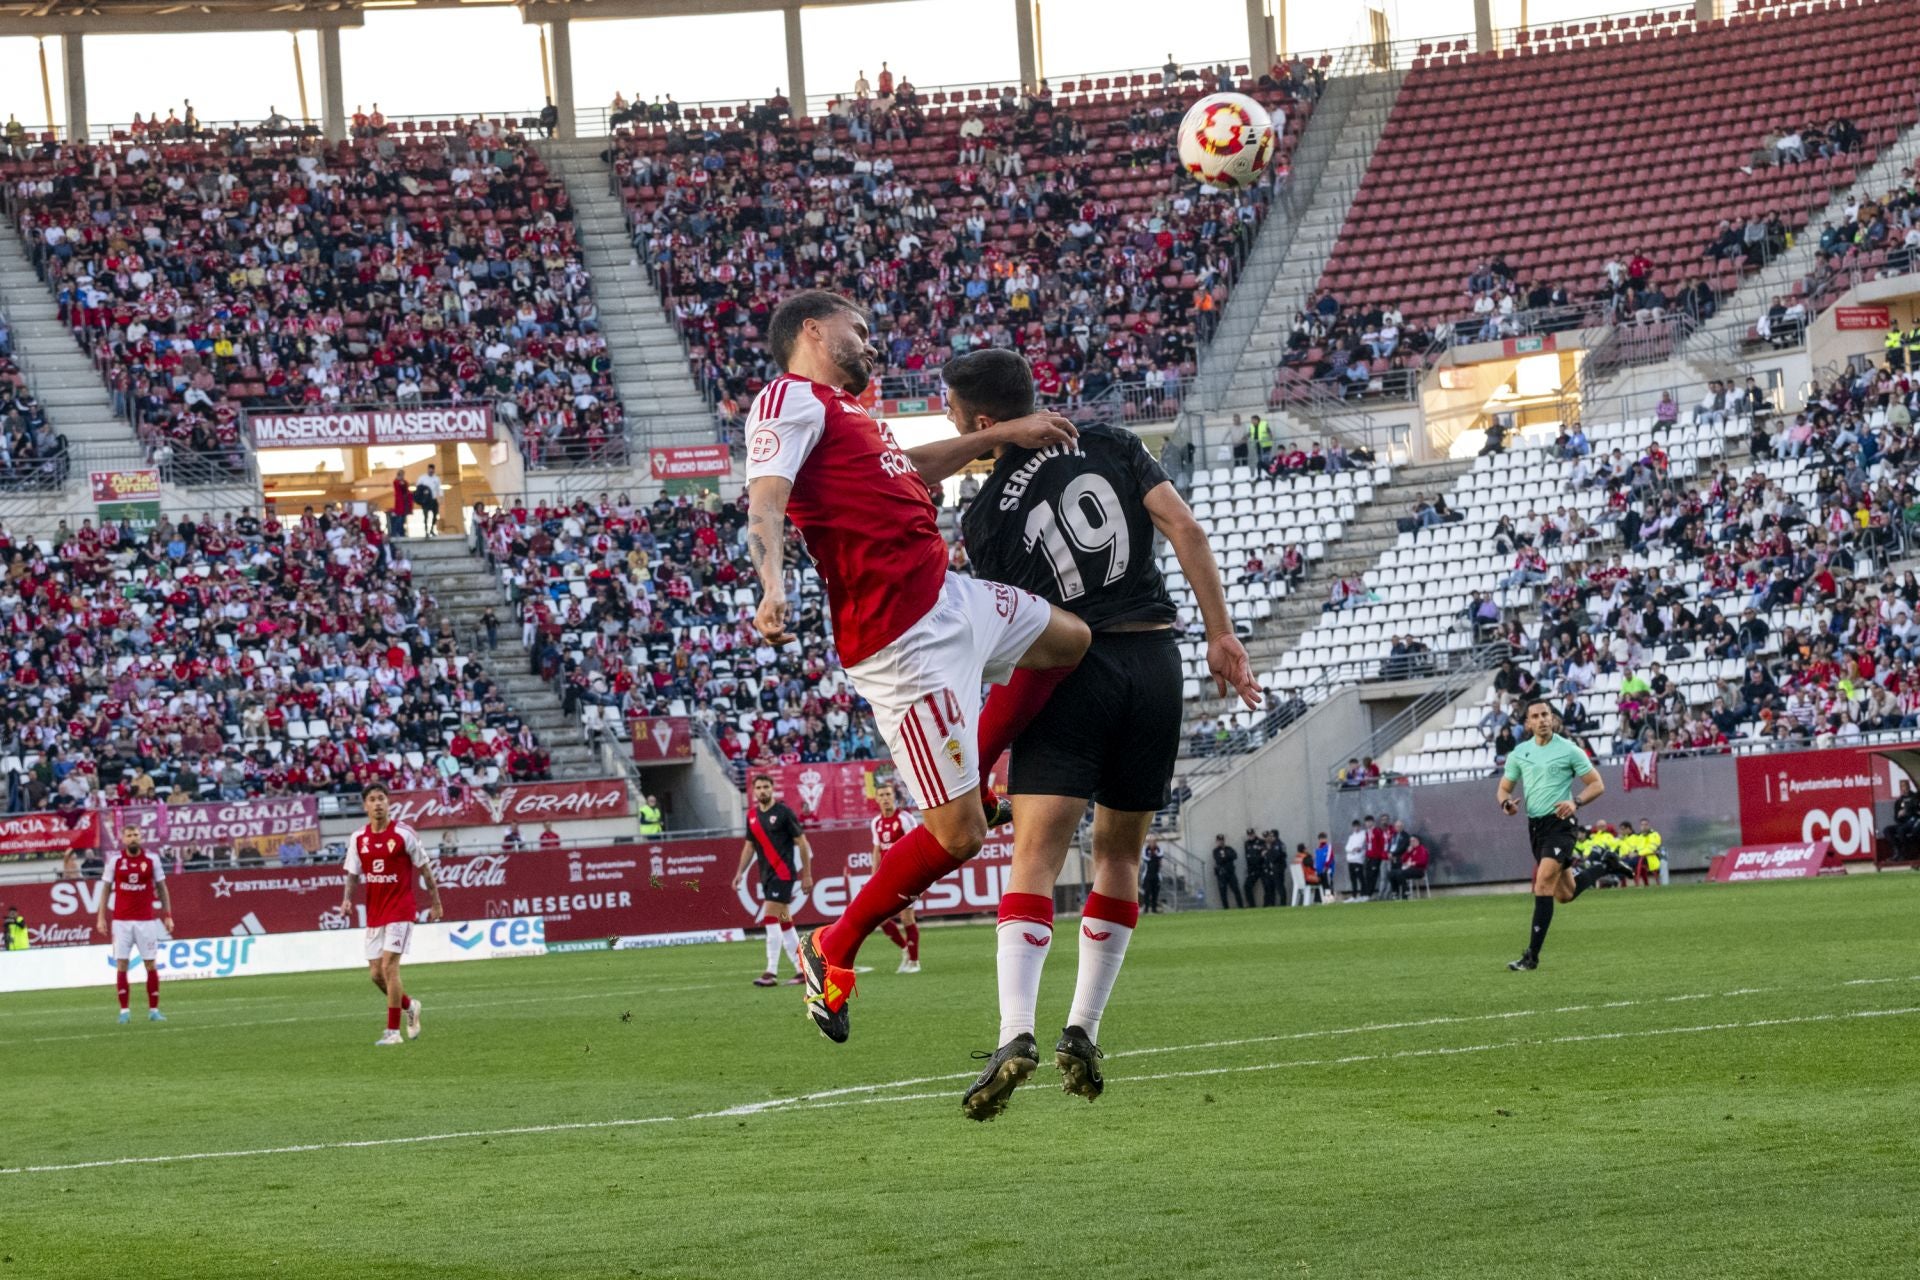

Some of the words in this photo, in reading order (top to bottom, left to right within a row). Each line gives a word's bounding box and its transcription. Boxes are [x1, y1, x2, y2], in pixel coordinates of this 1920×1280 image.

[255, 414, 369, 440] MASERCON
[374, 409, 486, 435] MASERCON
[1022, 472, 1130, 602] 19
[923, 687, 966, 739] 14
[1789, 776, 1842, 793] Ayuntamiento
[1843, 775, 1854, 788] de
[515, 791, 621, 814] GRANA
[141, 807, 209, 827] PEÑA
[217, 800, 305, 823] GRANA
[0, 817, 45, 836] URCIA
[169, 819, 264, 842] RINCON
[272, 815, 318, 836] DEL
[585, 860, 636, 871] Ayuntamiento
[666, 854, 717, 866] Ayuntamiento
[667, 867, 677, 876] de
[677, 865, 704, 874] Murcia
[419, 854, 509, 889] Coca-Cola
[586, 873, 595, 881] de
[596, 870, 623, 880] Murcia
[234, 878, 300, 892] ESTRELLA
[513, 891, 632, 915] MESEGUER
[28, 923, 92, 943] Murcia
[558, 941, 609, 952] LEVANTE
